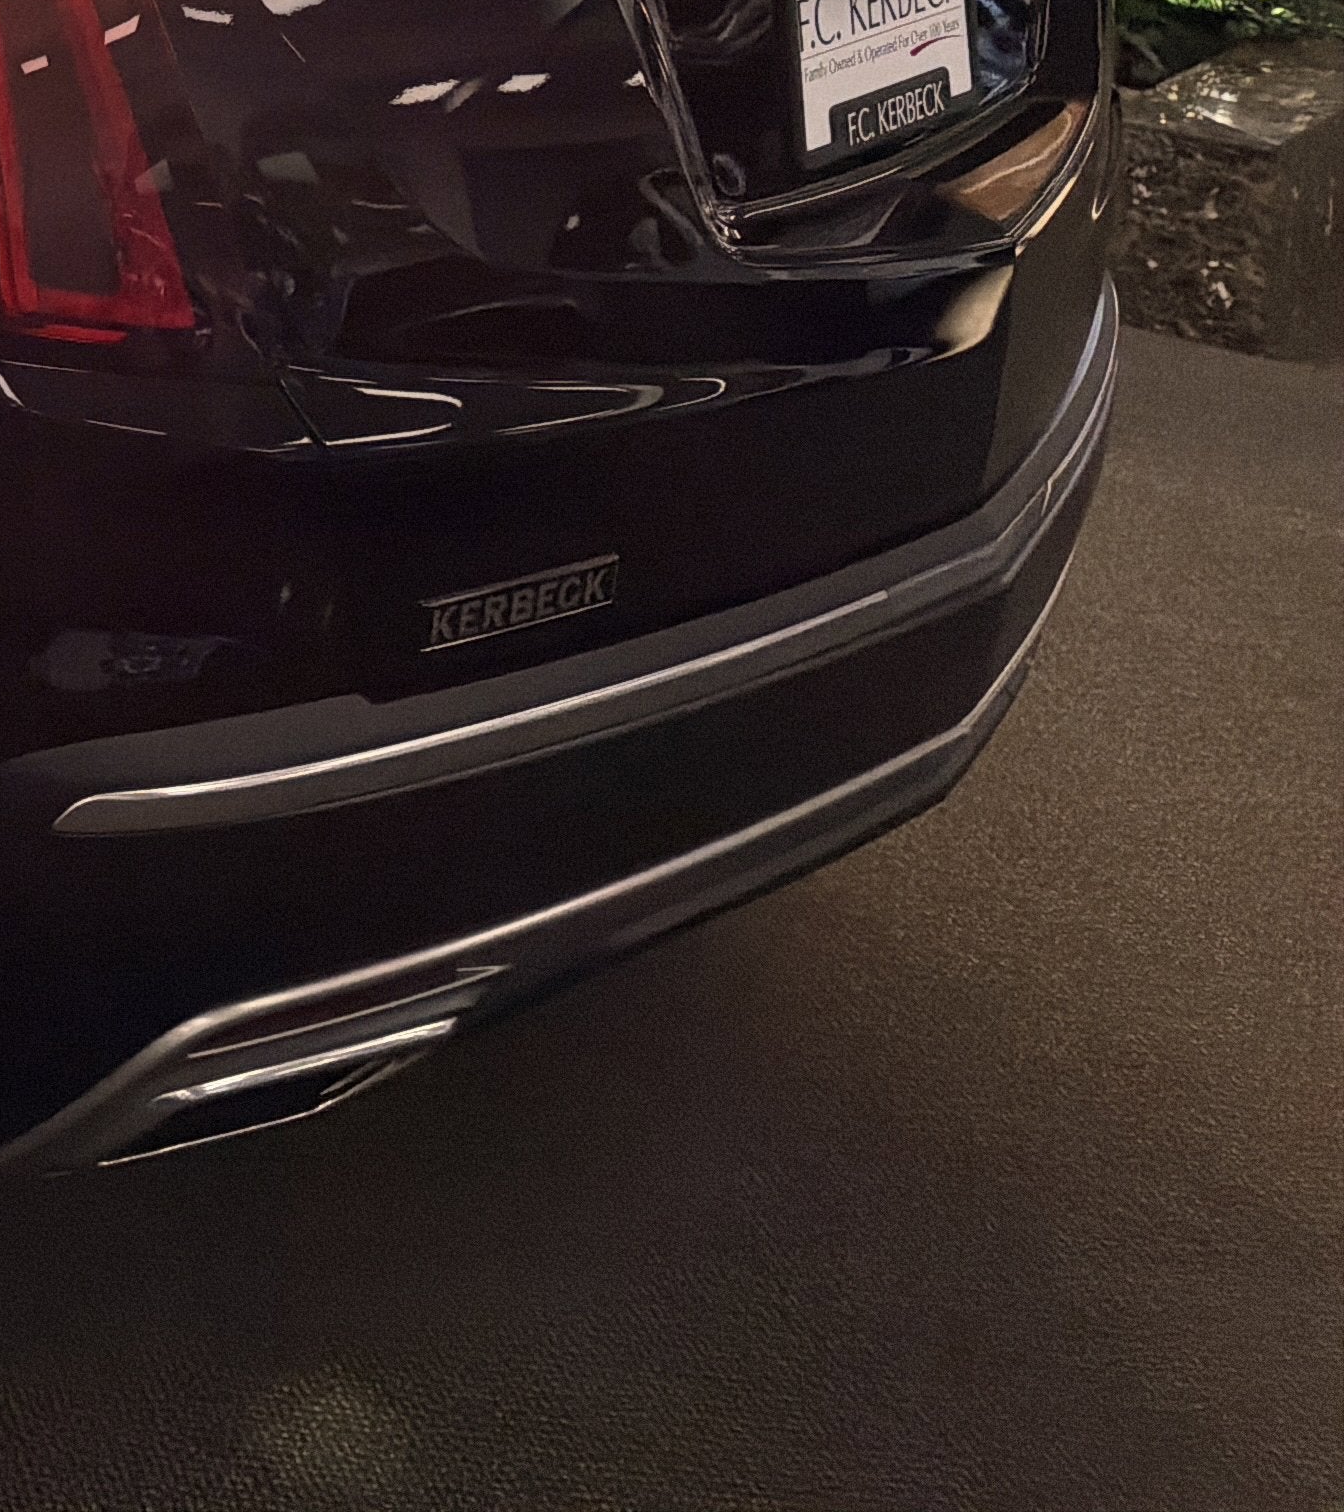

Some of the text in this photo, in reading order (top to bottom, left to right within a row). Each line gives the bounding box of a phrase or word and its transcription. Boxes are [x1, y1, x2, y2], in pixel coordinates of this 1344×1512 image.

[847, 80, 945, 147] F.C. KERBECK
[430, 566, 609, 644] KERBECK
